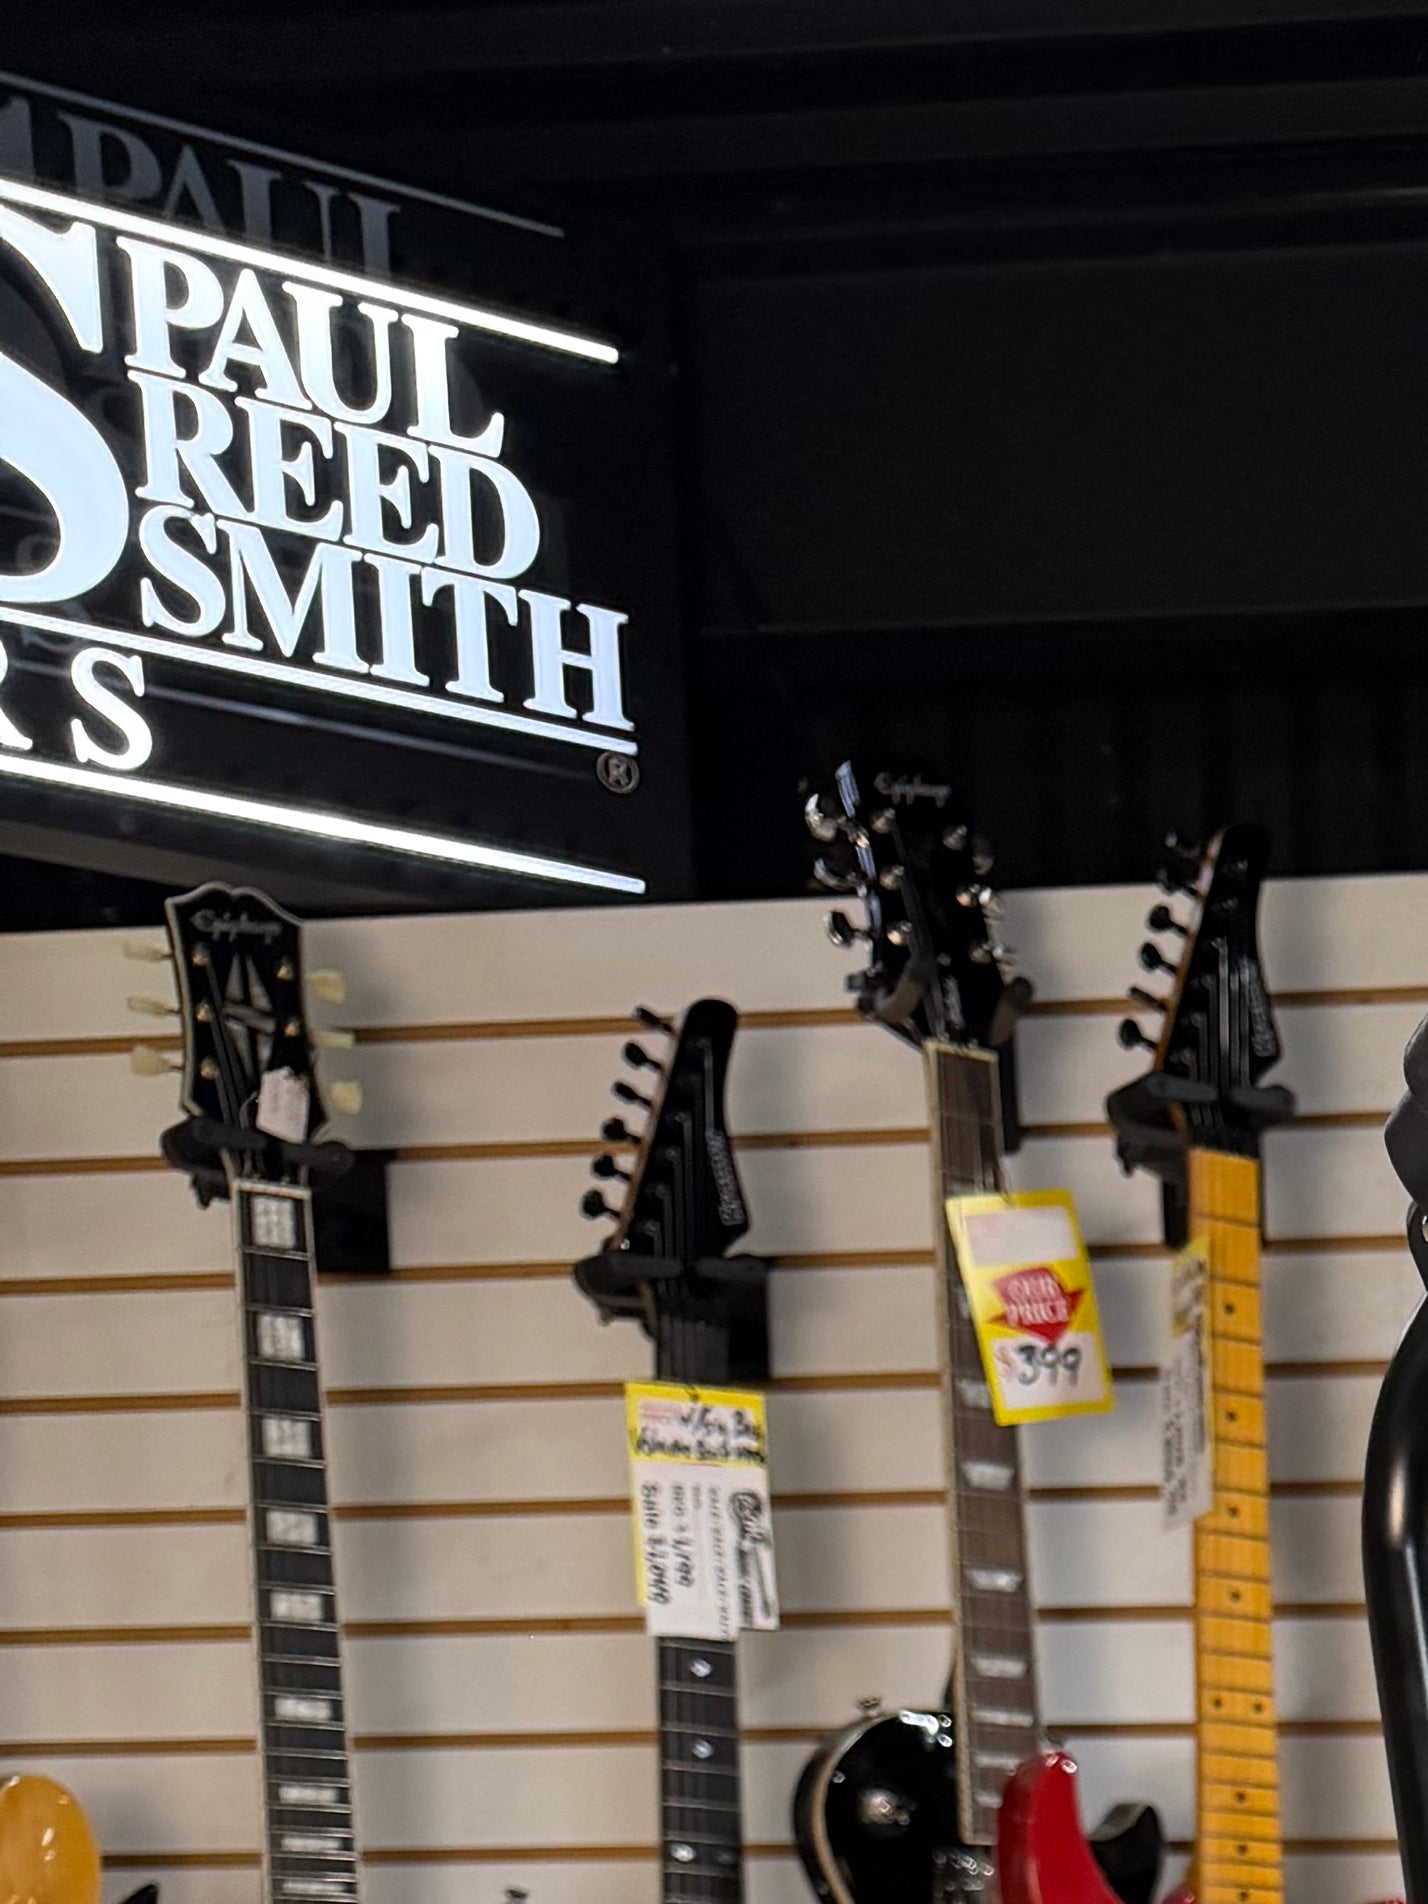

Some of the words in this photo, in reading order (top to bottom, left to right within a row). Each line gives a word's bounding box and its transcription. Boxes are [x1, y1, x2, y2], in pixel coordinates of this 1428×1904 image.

[116, 235, 507, 458] PAUL
[127, 369, 541, 580] REED
[138, 504, 636, 733] SMITH
[1006, 1297, 1072, 1327] PRICE
[1007, 1274, 1061, 1303] OUR
[995, 1344, 1082, 1388] $399
